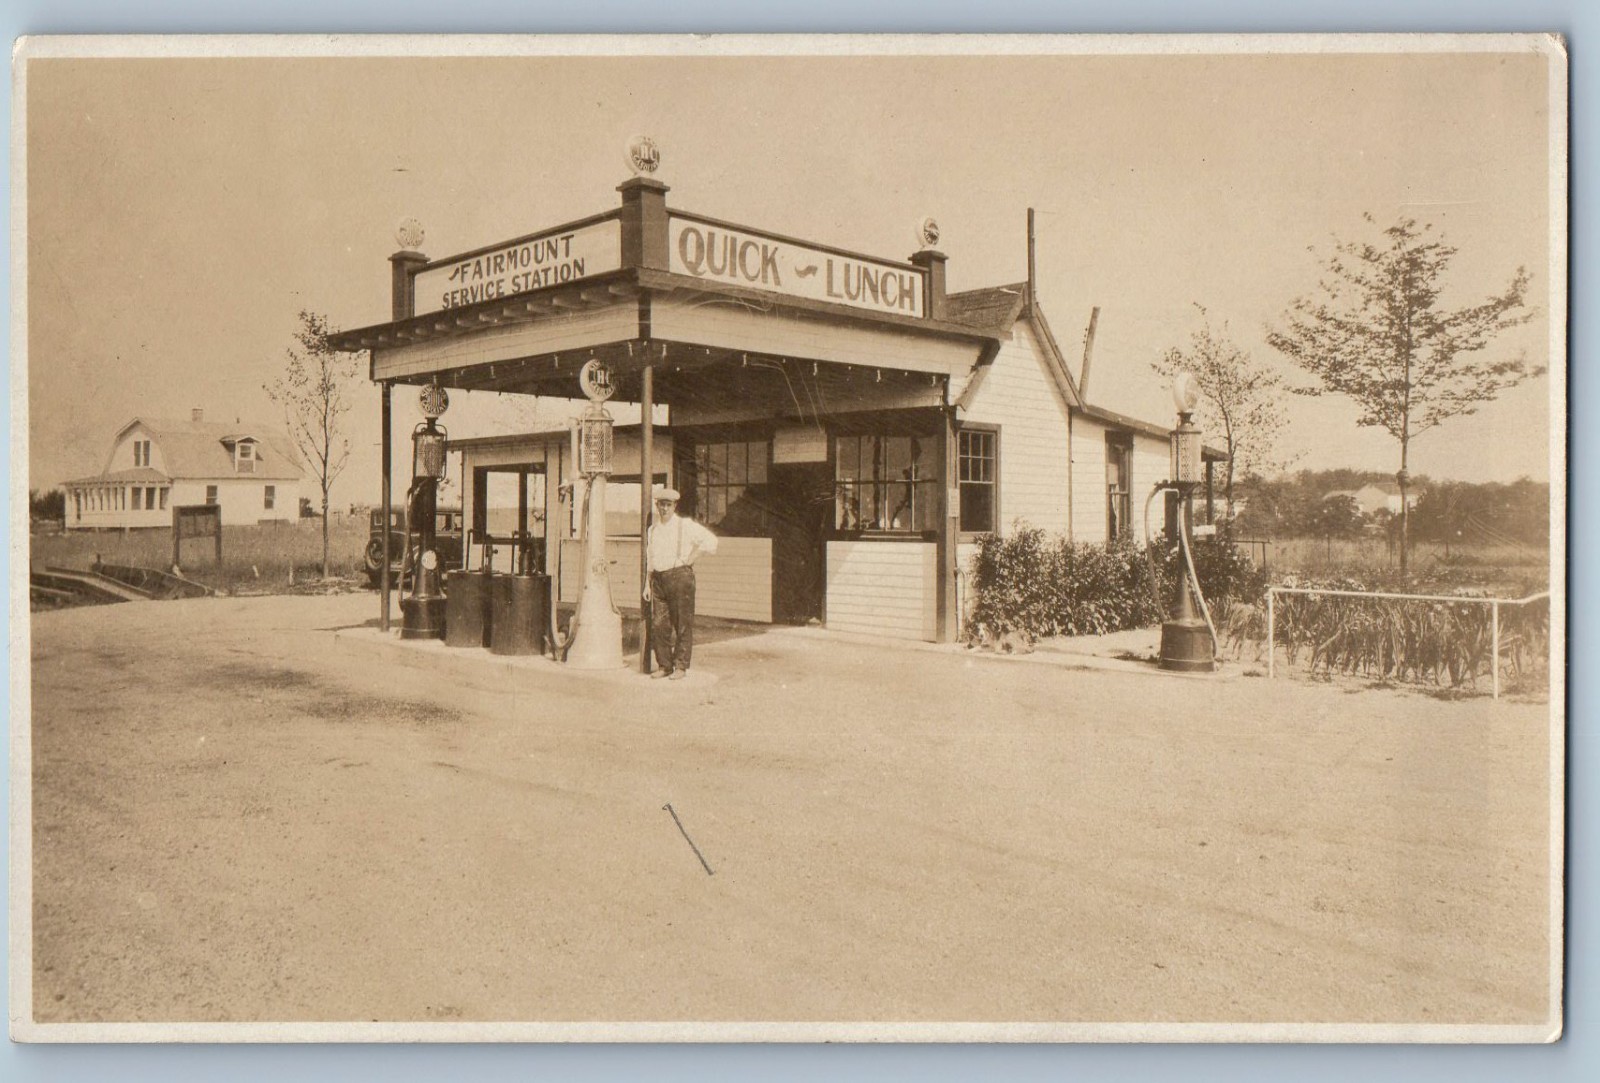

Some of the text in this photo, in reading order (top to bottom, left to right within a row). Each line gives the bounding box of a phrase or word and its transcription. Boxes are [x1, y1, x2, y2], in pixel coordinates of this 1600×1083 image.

[442, 257, 586, 310] SERVICE STATION
[460, 234, 575, 284] FAIRMOUNT
[678, 226, 916, 312] QUICK LUNCH
